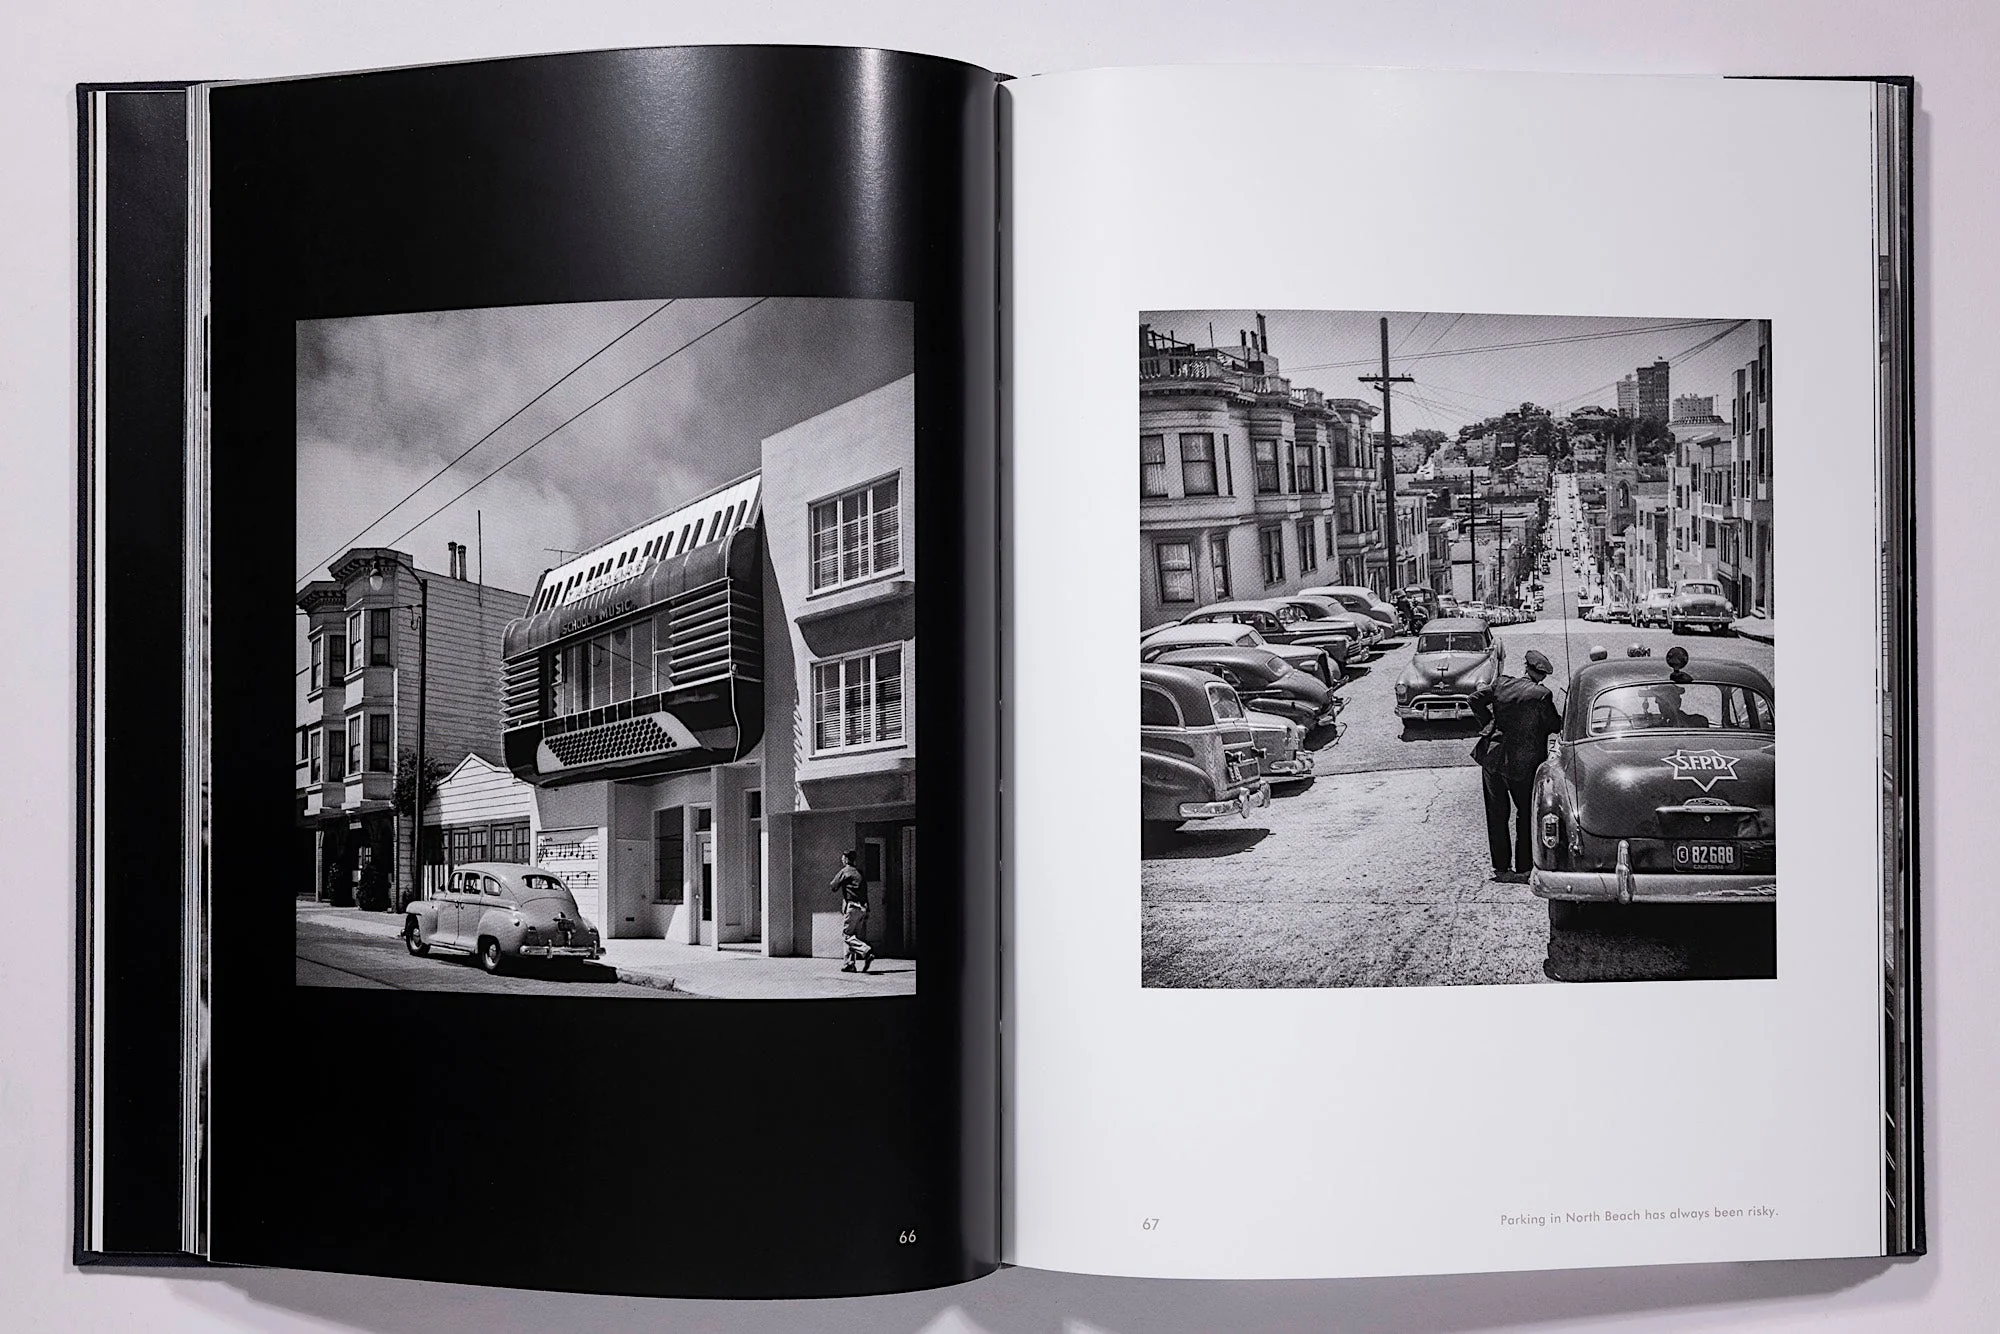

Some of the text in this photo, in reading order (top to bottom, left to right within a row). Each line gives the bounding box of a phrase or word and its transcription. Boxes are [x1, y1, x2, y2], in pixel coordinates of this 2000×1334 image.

[562, 614, 592, 635] SCHOOL
[599, 599, 632, 621] MUSIC
[1676, 755, 1728, 770] S.F.P.D.
[1500, 1205, 1779, 1227] Parking in North Beach has always been risky.
[1142, 1217, 1160, 1231] 67
[899, 1229, 917, 1244] 66
